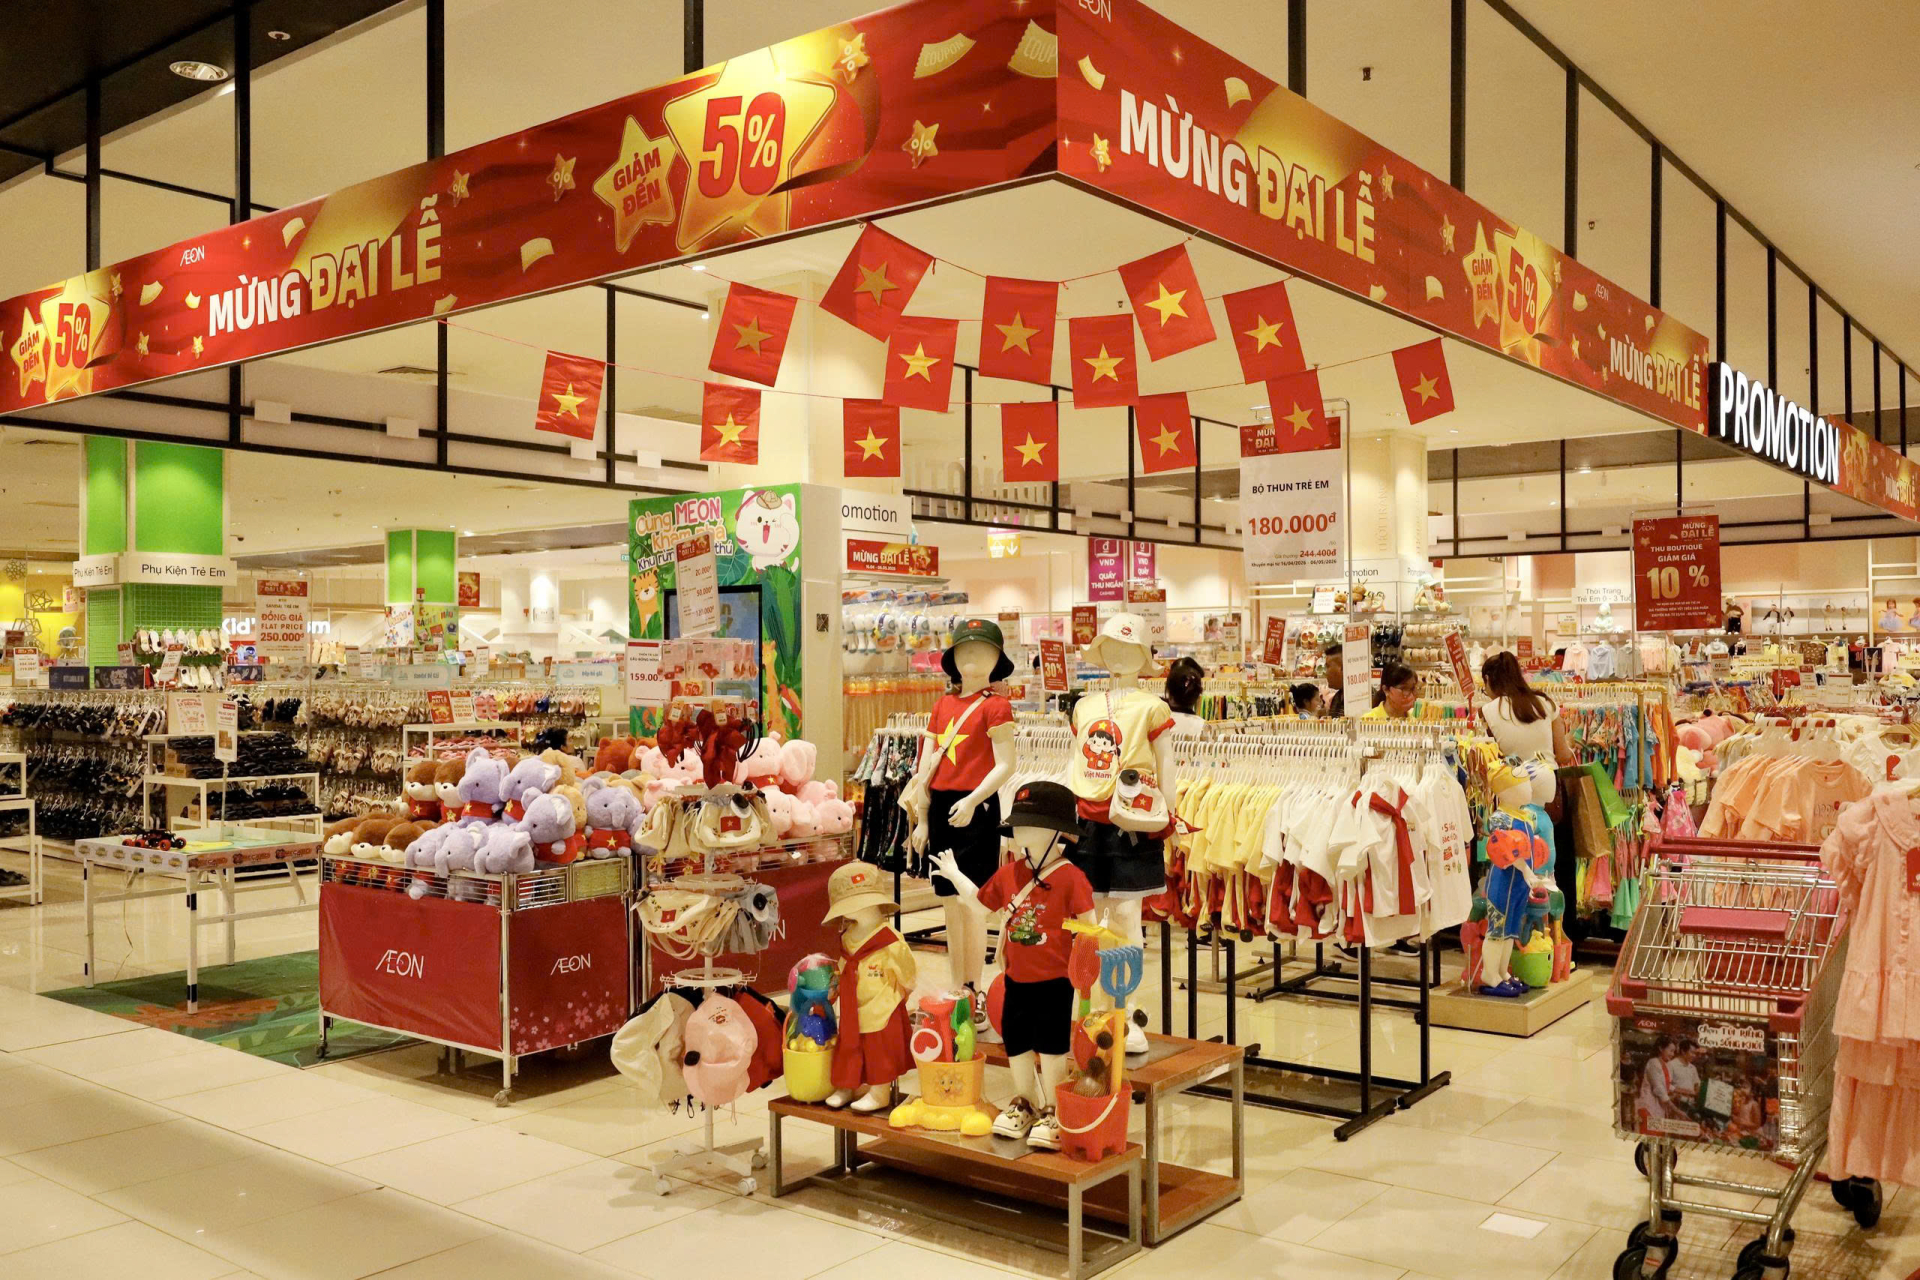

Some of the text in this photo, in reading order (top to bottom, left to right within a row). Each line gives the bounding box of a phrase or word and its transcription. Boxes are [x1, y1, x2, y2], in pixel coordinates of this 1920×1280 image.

[613, 146, 661, 192] GIẢM
[1120, 89, 1375, 264] MỪNG ĐẠI LỄ
[622, 177, 661, 217] ĐẾN
[209, 193, 442, 337] MỪNG ĐẠI LỄ
[1472, 253, 1493, 276] GIẢM
[19, 330, 40, 356] GIẢM
[23, 351, 40, 374] ĐẾN
[1610, 335, 1701, 411] MỪNG ĐẠI LỄ
[1257, 427, 1276, 437] MỪN
[1719, 362, 1839, 486] PROMOTION
[1255, 437, 1275, 449] ĐẠI
[1252, 479, 1329, 495] BỘ THUN TRẺ EM
[675, 497, 721, 525] MEON
[637, 511, 673, 535] Cùng
[1248, 511, 1337, 536] 180.000đ
[1682, 522, 1706, 530] MỪNG
[1681, 525, 1715, 539] ĐẠI LỄ
[637, 540, 733, 570] Khu thú
[1666, 543, 1703, 552] BOUTIQUE
[853, 548, 909, 566] MỪNG ĐẠI LỄ
[1138, 558, 1149, 566] VND
[1658, 552, 1696, 562] GIẢM GIÁ
[141, 563, 226, 577] Phụ Kiện Trẻ Em
[1105, 581, 1123, 589] NGÂN
[1647, 565, 1710, 600] 10 %
[1602, 588, 1621, 597] Trang
[261, 610, 303, 622] ĐỒNG GIÁ
[260, 632, 304, 642] 250.000đ
[630, 672, 661, 682] 159.00
[1084, 771, 1095, 779] Việt
